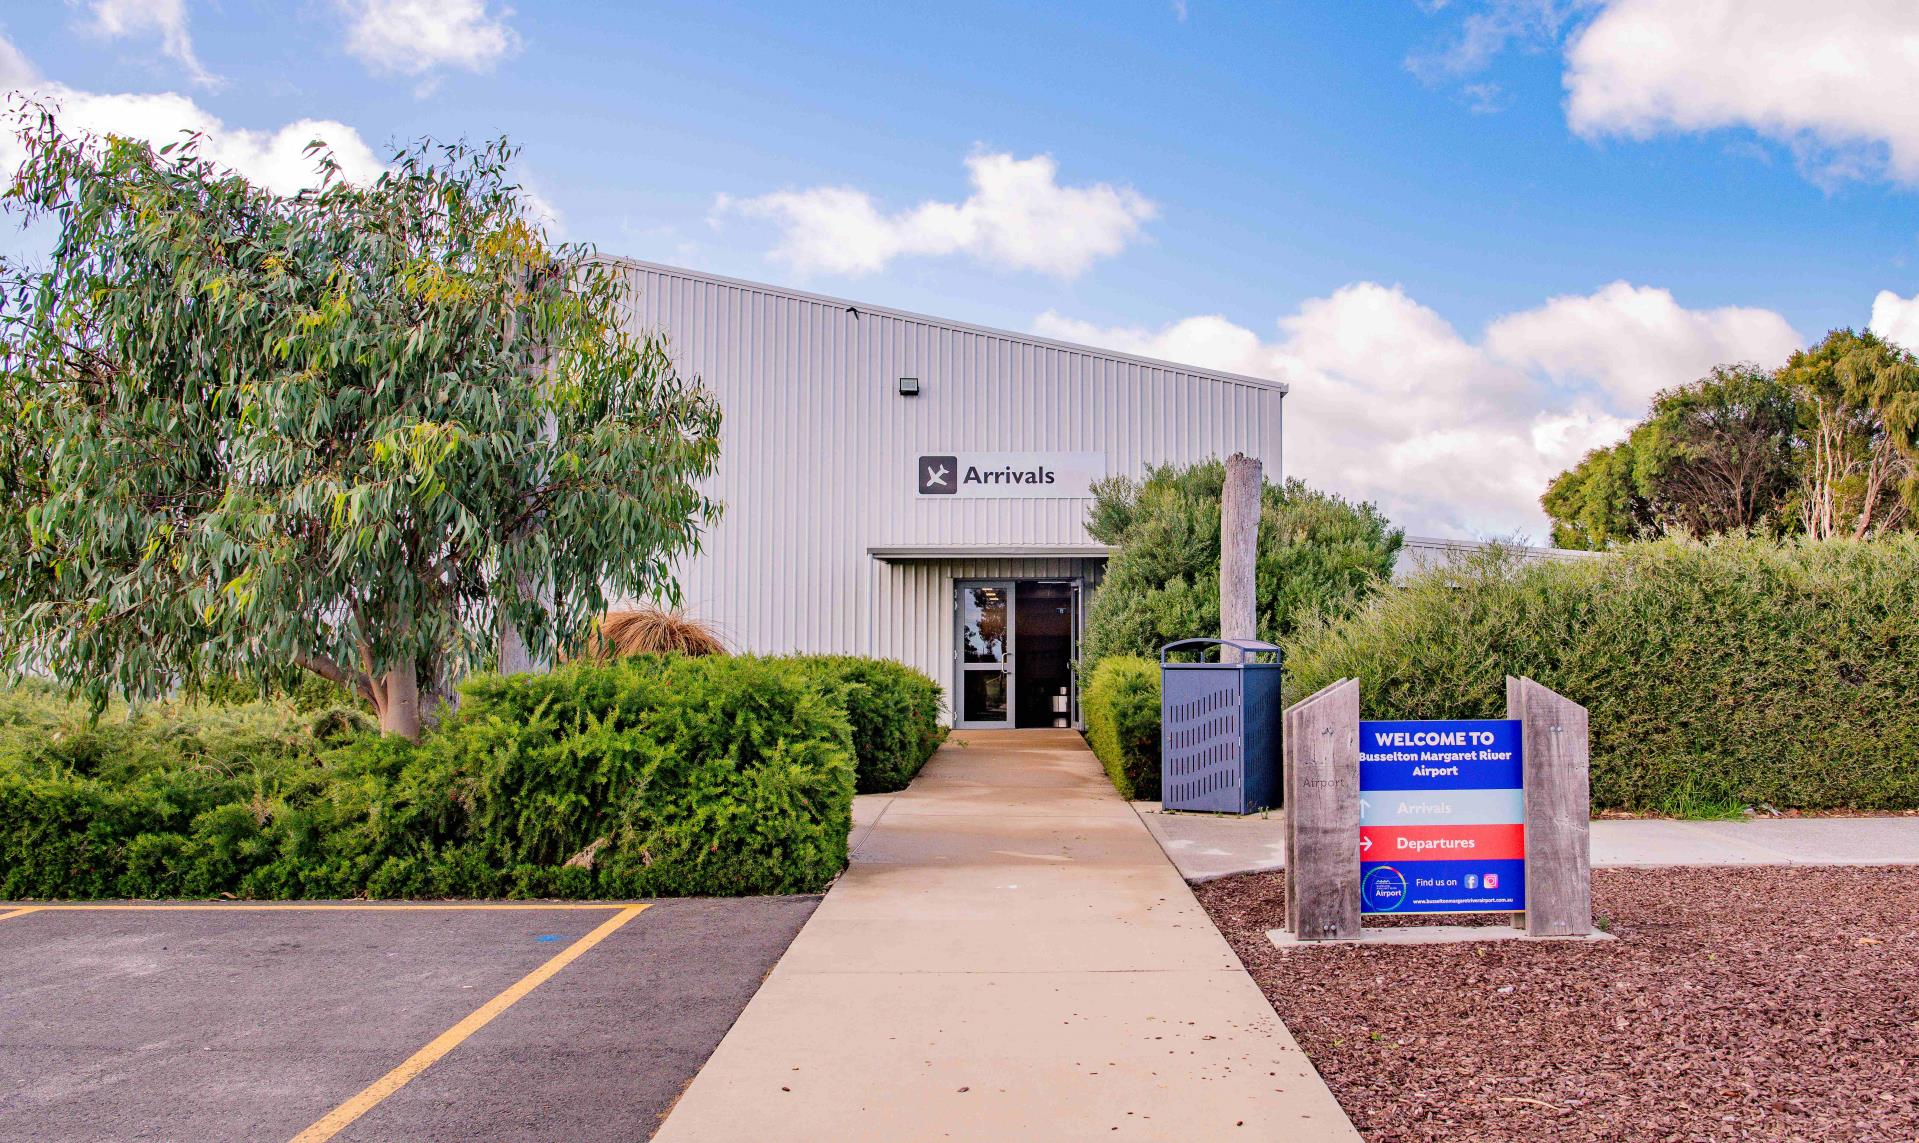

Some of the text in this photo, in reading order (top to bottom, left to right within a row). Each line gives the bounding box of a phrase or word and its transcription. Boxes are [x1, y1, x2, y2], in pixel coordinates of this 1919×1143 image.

[963, 466, 1055, 484] Arrivals
[1375, 731, 1495, 747] WELCOME TO
[1359, 749, 1512, 763] Busselton Margaret River
[1412, 765, 1459, 778] Airport
[1303, 778, 1345, 790] Airport
[1397, 802, 1452, 815] Arrivals
[1397, 837, 1475, 852] Departures
[1416, 878, 1433, 887] Find
[1376, 889, 1402, 897] Airport
